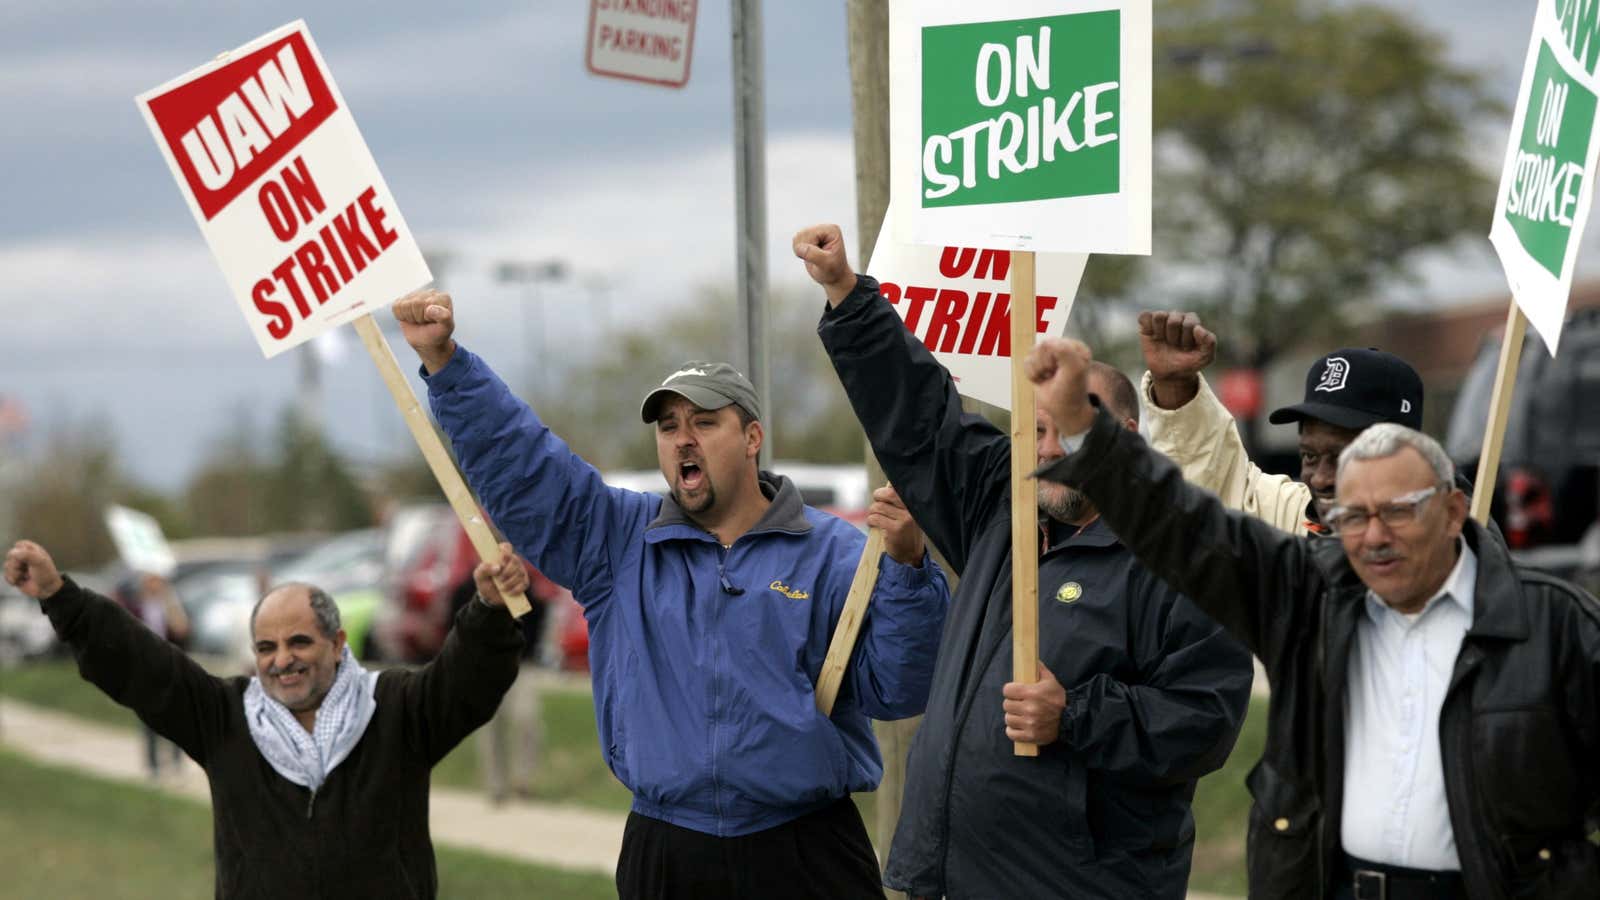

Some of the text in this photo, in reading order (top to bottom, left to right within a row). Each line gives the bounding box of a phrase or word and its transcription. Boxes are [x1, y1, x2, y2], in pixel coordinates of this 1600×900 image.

[600, 24, 681, 61] PARKING
[975, 26, 1051, 107] ON
[1555, 0, 1600, 77] AW
[180, 43, 314, 190] UAW
[923, 81, 1119, 199] STRIKE
[1537, 77, 1568, 148] ON
[258, 154, 327, 243] ON
[1507, 149, 1584, 227] STRIKE
[251, 185, 399, 341] STRIKE
[1400, 398, 1412, 414] D
